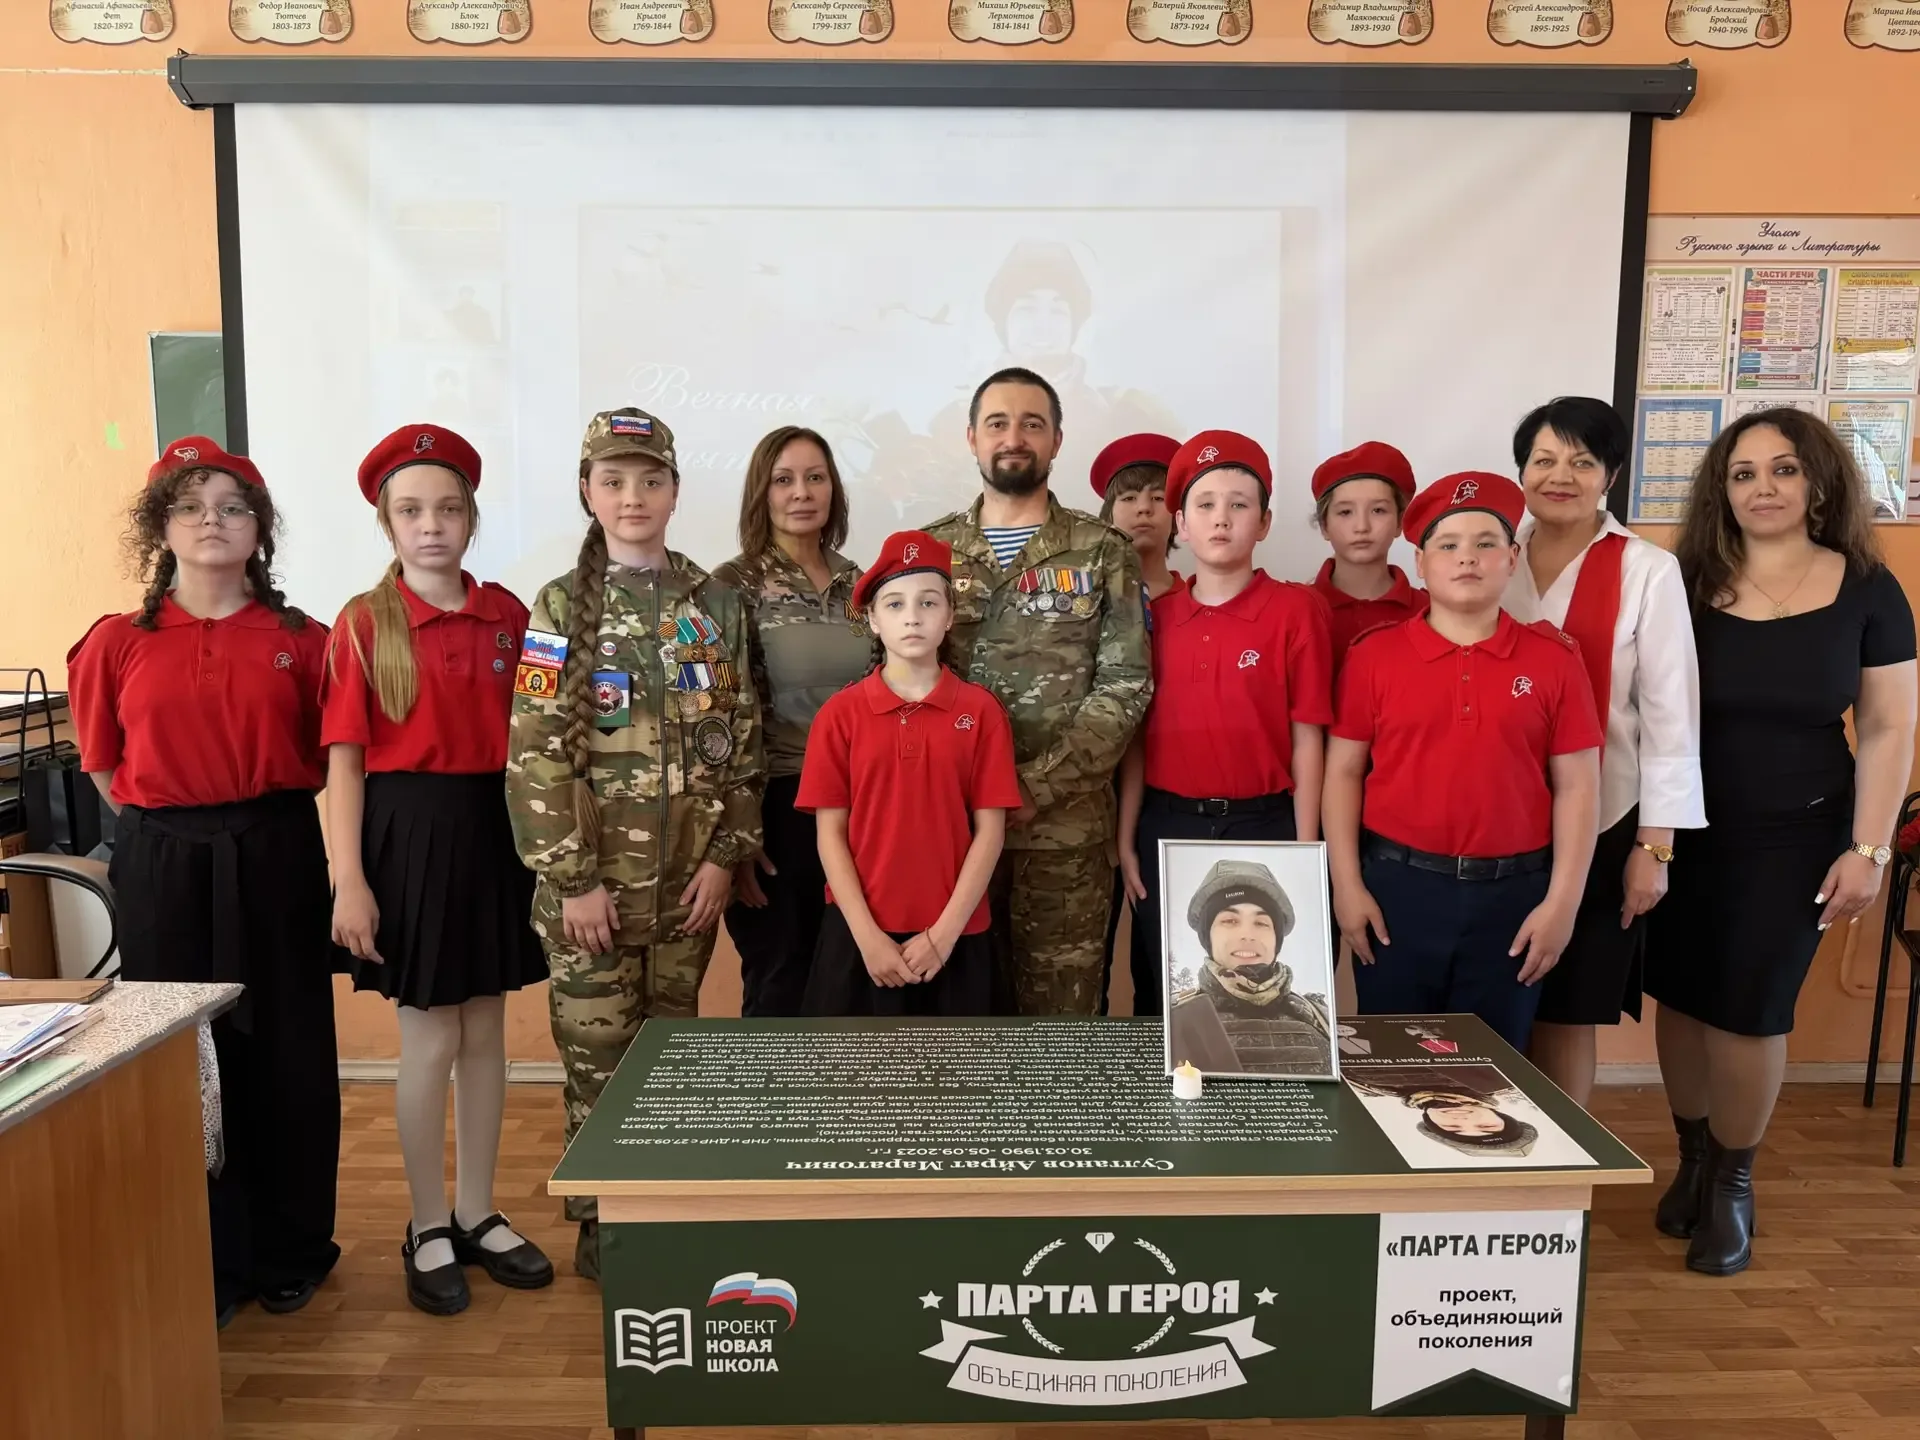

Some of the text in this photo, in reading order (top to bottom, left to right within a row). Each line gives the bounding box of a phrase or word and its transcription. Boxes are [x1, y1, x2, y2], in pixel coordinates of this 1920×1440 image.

[106, 2, 154, 10] Афанасьеви
[258, 2, 282, 10] Федор
[418, 2, 520, 10] Александр Александрович
[620, 2, 682, 10] Иван Андреевич
[790, 2, 831, 10] Александр
[1010, 2, 1045, 10] Юрьевич
[1152, 2, 1230, 10] Валерий Яковлевич
[1507, 4, 1534, 12] Сергей
[1686, 5, 1713, 14] Иосиф
[103, 12, 120, 20] Фет
[814, 12, 848, 20] Пушкин
[988, 12, 1034, 20] Лермонтов
[1872, 8, 1904, 16] Марина
[1536, 14, 1564, 22] Есенин
[1710, 16, 1748, 24] Бродский
[1758, 221, 1801, 238] Уголок
[1676, 235, 1732, 256] Русского
[1736, 243, 1774, 256] языка
[1792, 236, 1881, 256] Литературы
[1756, 270, 1814, 278] ЧАСТИ РЕЧИ
[1002, 1147, 1092, 1156] 30.03.1990
[785, 1158, 1174, 1171] Султанов Айрат Маратович
[1386, 1232, 1578, 1257] «ПАРТА ГЕРОЯ»
[957, 1280, 1240, 1317] ПАРТА ГЕРОЯ
[1439, 1289, 1517, 1306] проект,
[1390, 1308, 1562, 1328] объединяющий
[706, 1320, 777, 1334] ПРОЕКТ
[706, 1339, 772, 1353] НОВАЯ
[1418, 1335, 1533, 1349] поколения
[706, 1358, 780, 1373] ШКОЛА
[968, 1359, 1227, 1393] ОБЪЕДИНЯЯ ПОКОЛЕНИЯ
